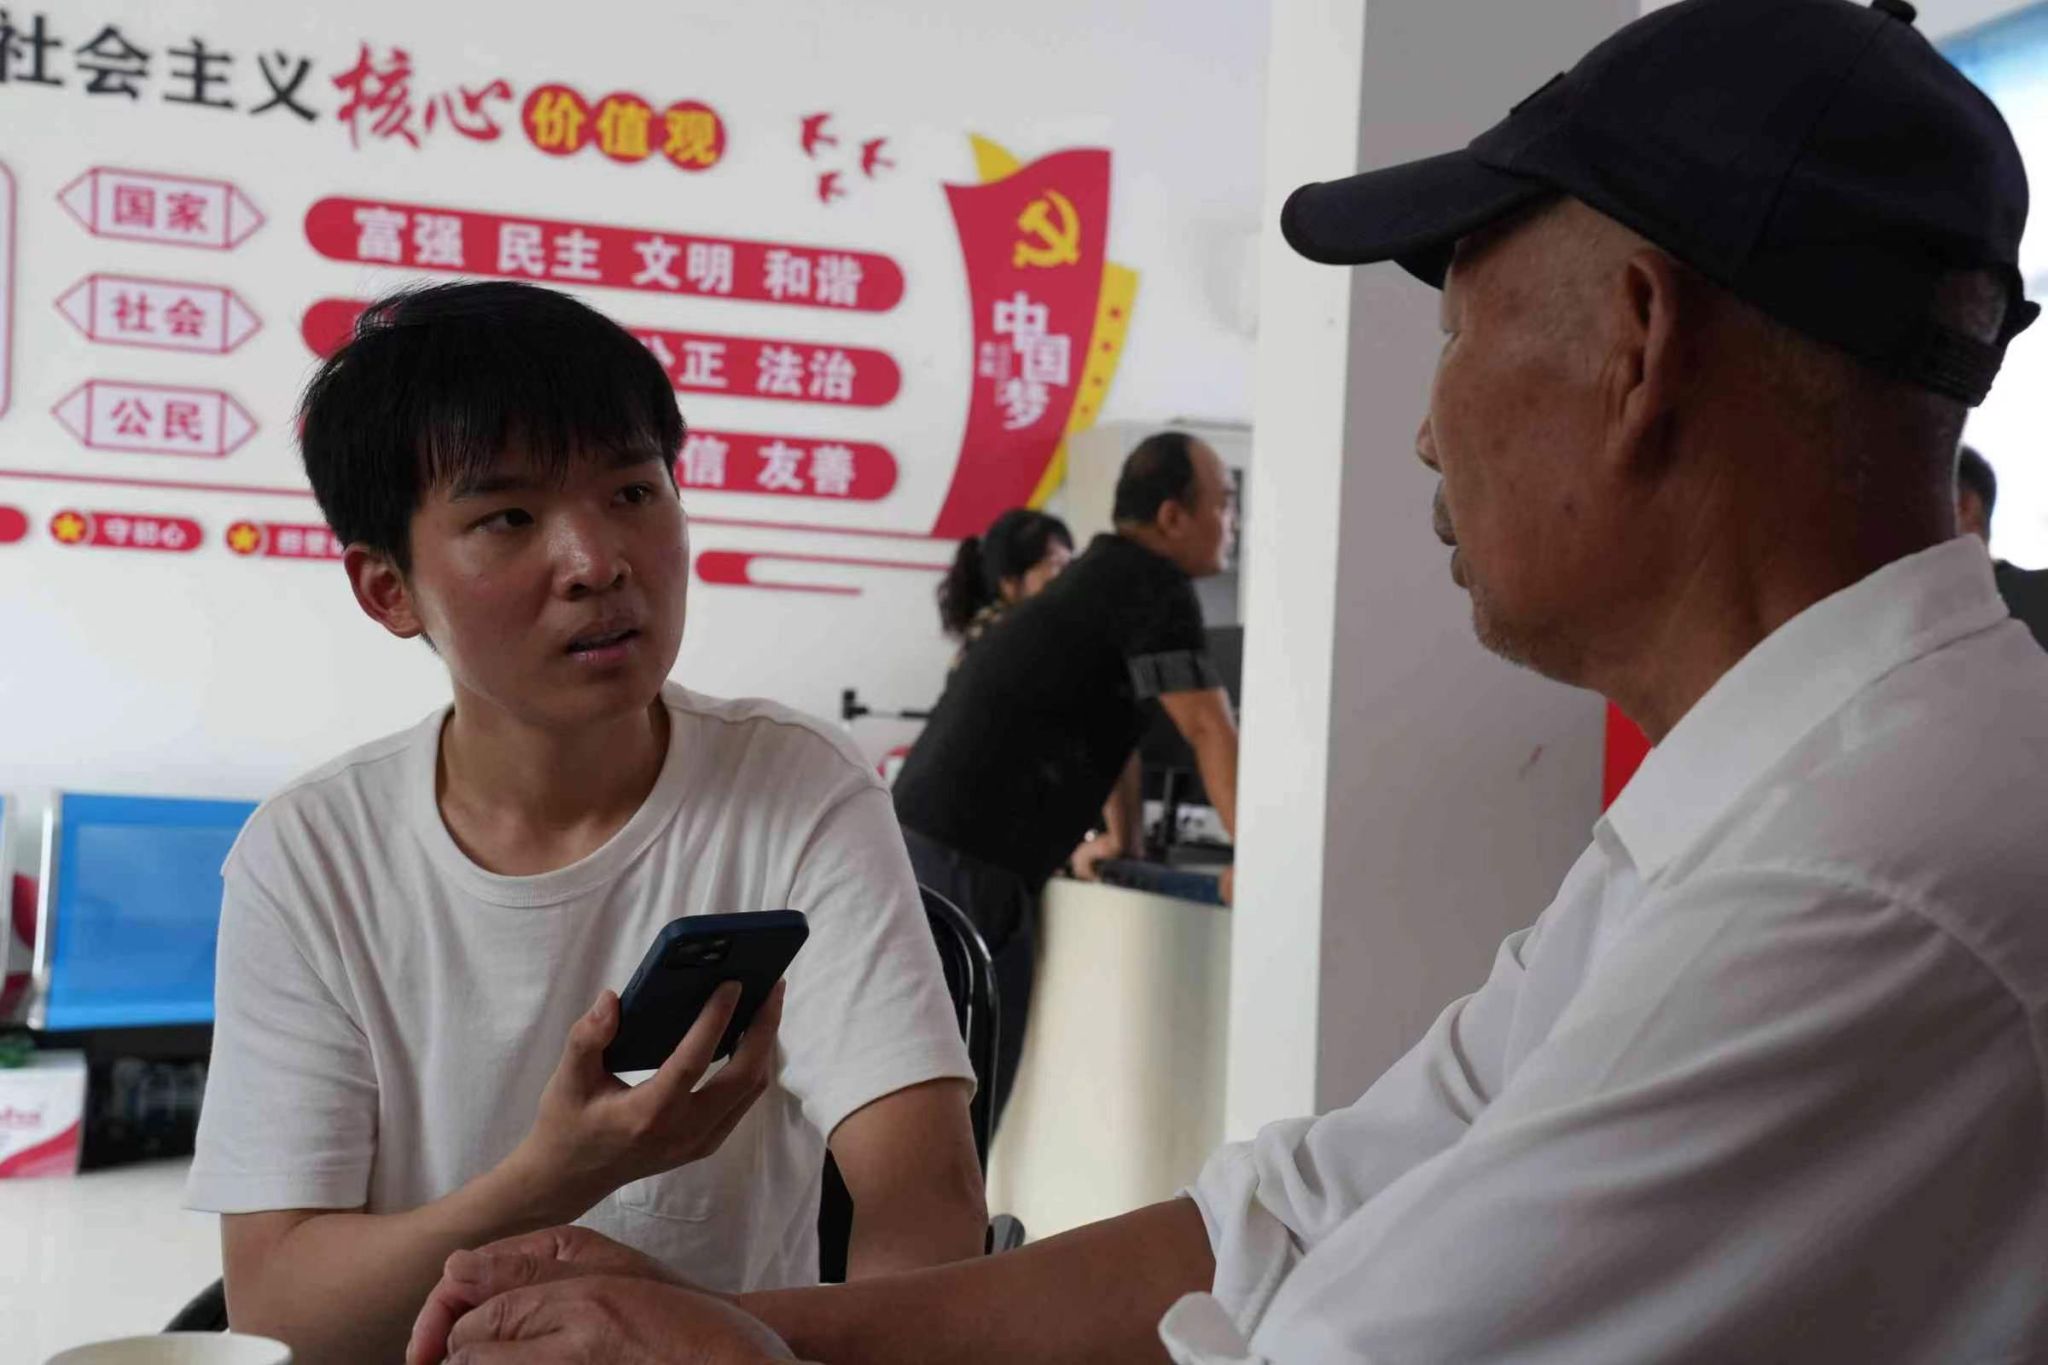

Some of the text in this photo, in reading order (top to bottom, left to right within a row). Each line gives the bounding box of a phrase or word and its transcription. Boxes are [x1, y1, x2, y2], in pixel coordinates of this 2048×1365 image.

[0, 8, 718, 166] 社会主义核心价值观
[113, 185, 208, 231] 国家
[353, 207, 864, 306] 富强 民主 文明 和谐
[114, 291, 207, 335] 社会
[756, 345, 856, 399] 法治
[993, 290, 1071, 430] 中国梦
[111, 400, 203, 441] 公民
[757, 441, 855, 494] 友善
